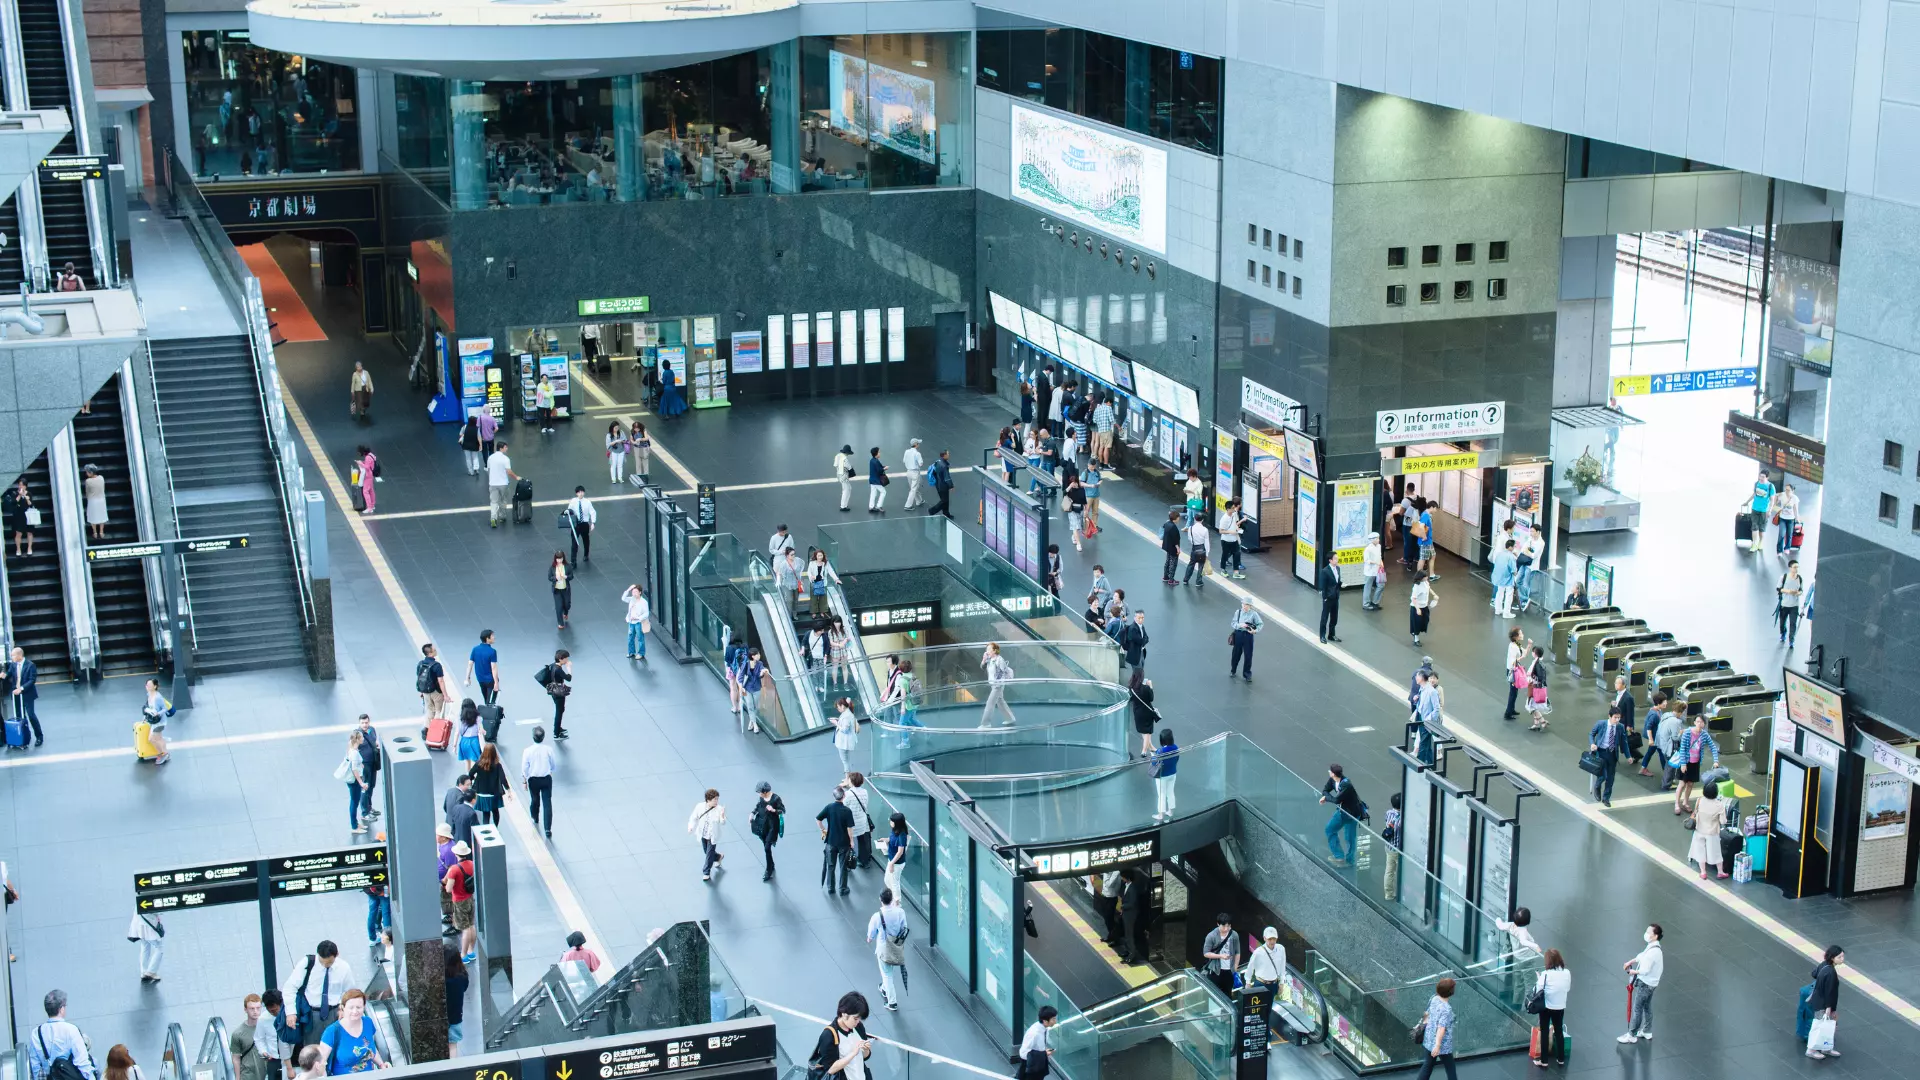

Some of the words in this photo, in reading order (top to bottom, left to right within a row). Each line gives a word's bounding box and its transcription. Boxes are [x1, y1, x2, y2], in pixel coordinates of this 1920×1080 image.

[248, 195, 317, 218] 京都劇場
[1254, 386, 1289, 410] Information
[1404, 409, 1479, 424] Information
[891, 608, 916, 619] お手洗
[680, 1040, 694, 1048] バス
[721, 1034, 746, 1043] タクシー
[613, 1046, 647, 1058] 鉄道案内所
[680, 1052, 701, 1062] 地下鉄
[613, 1058, 660, 1072] バス総合案内所
[623, 1067, 650, 1075] Information
